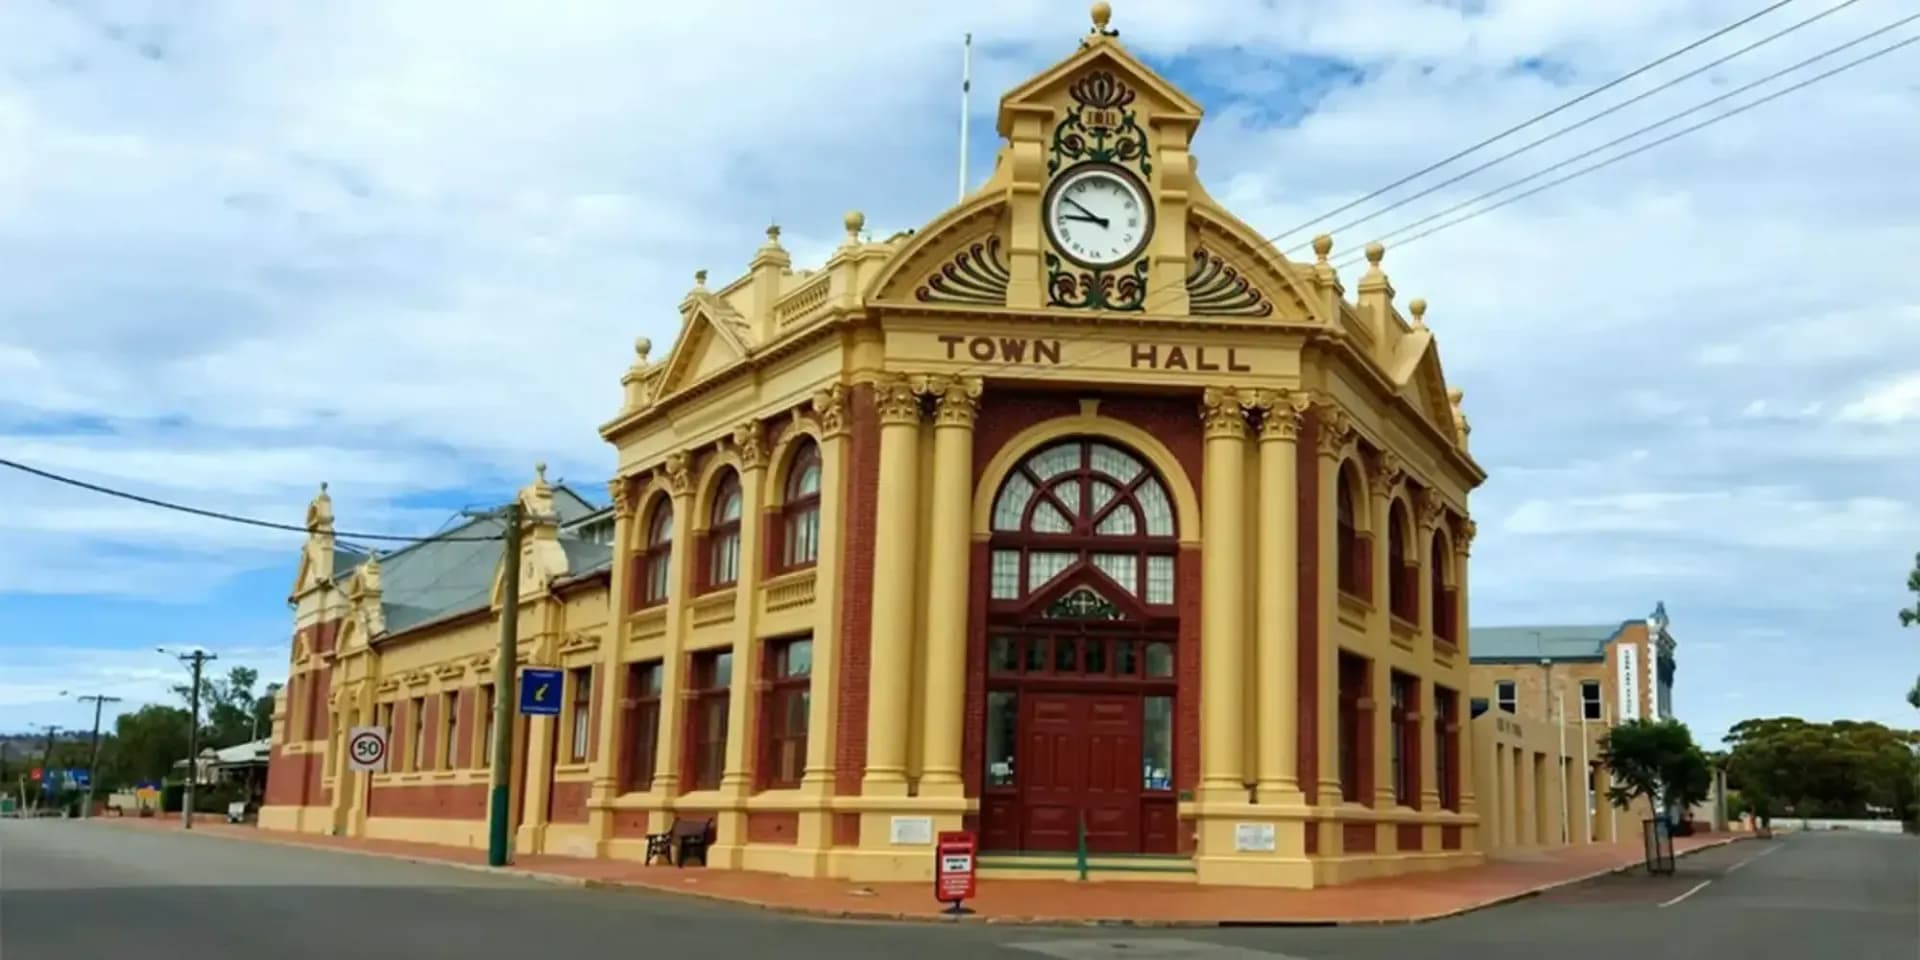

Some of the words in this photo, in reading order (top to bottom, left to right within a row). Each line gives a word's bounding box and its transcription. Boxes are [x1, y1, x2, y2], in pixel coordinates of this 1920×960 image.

[938, 336, 1061, 364] TOWN
[1131, 344, 1251, 371] HALL
[357, 741, 378, 756] 50
